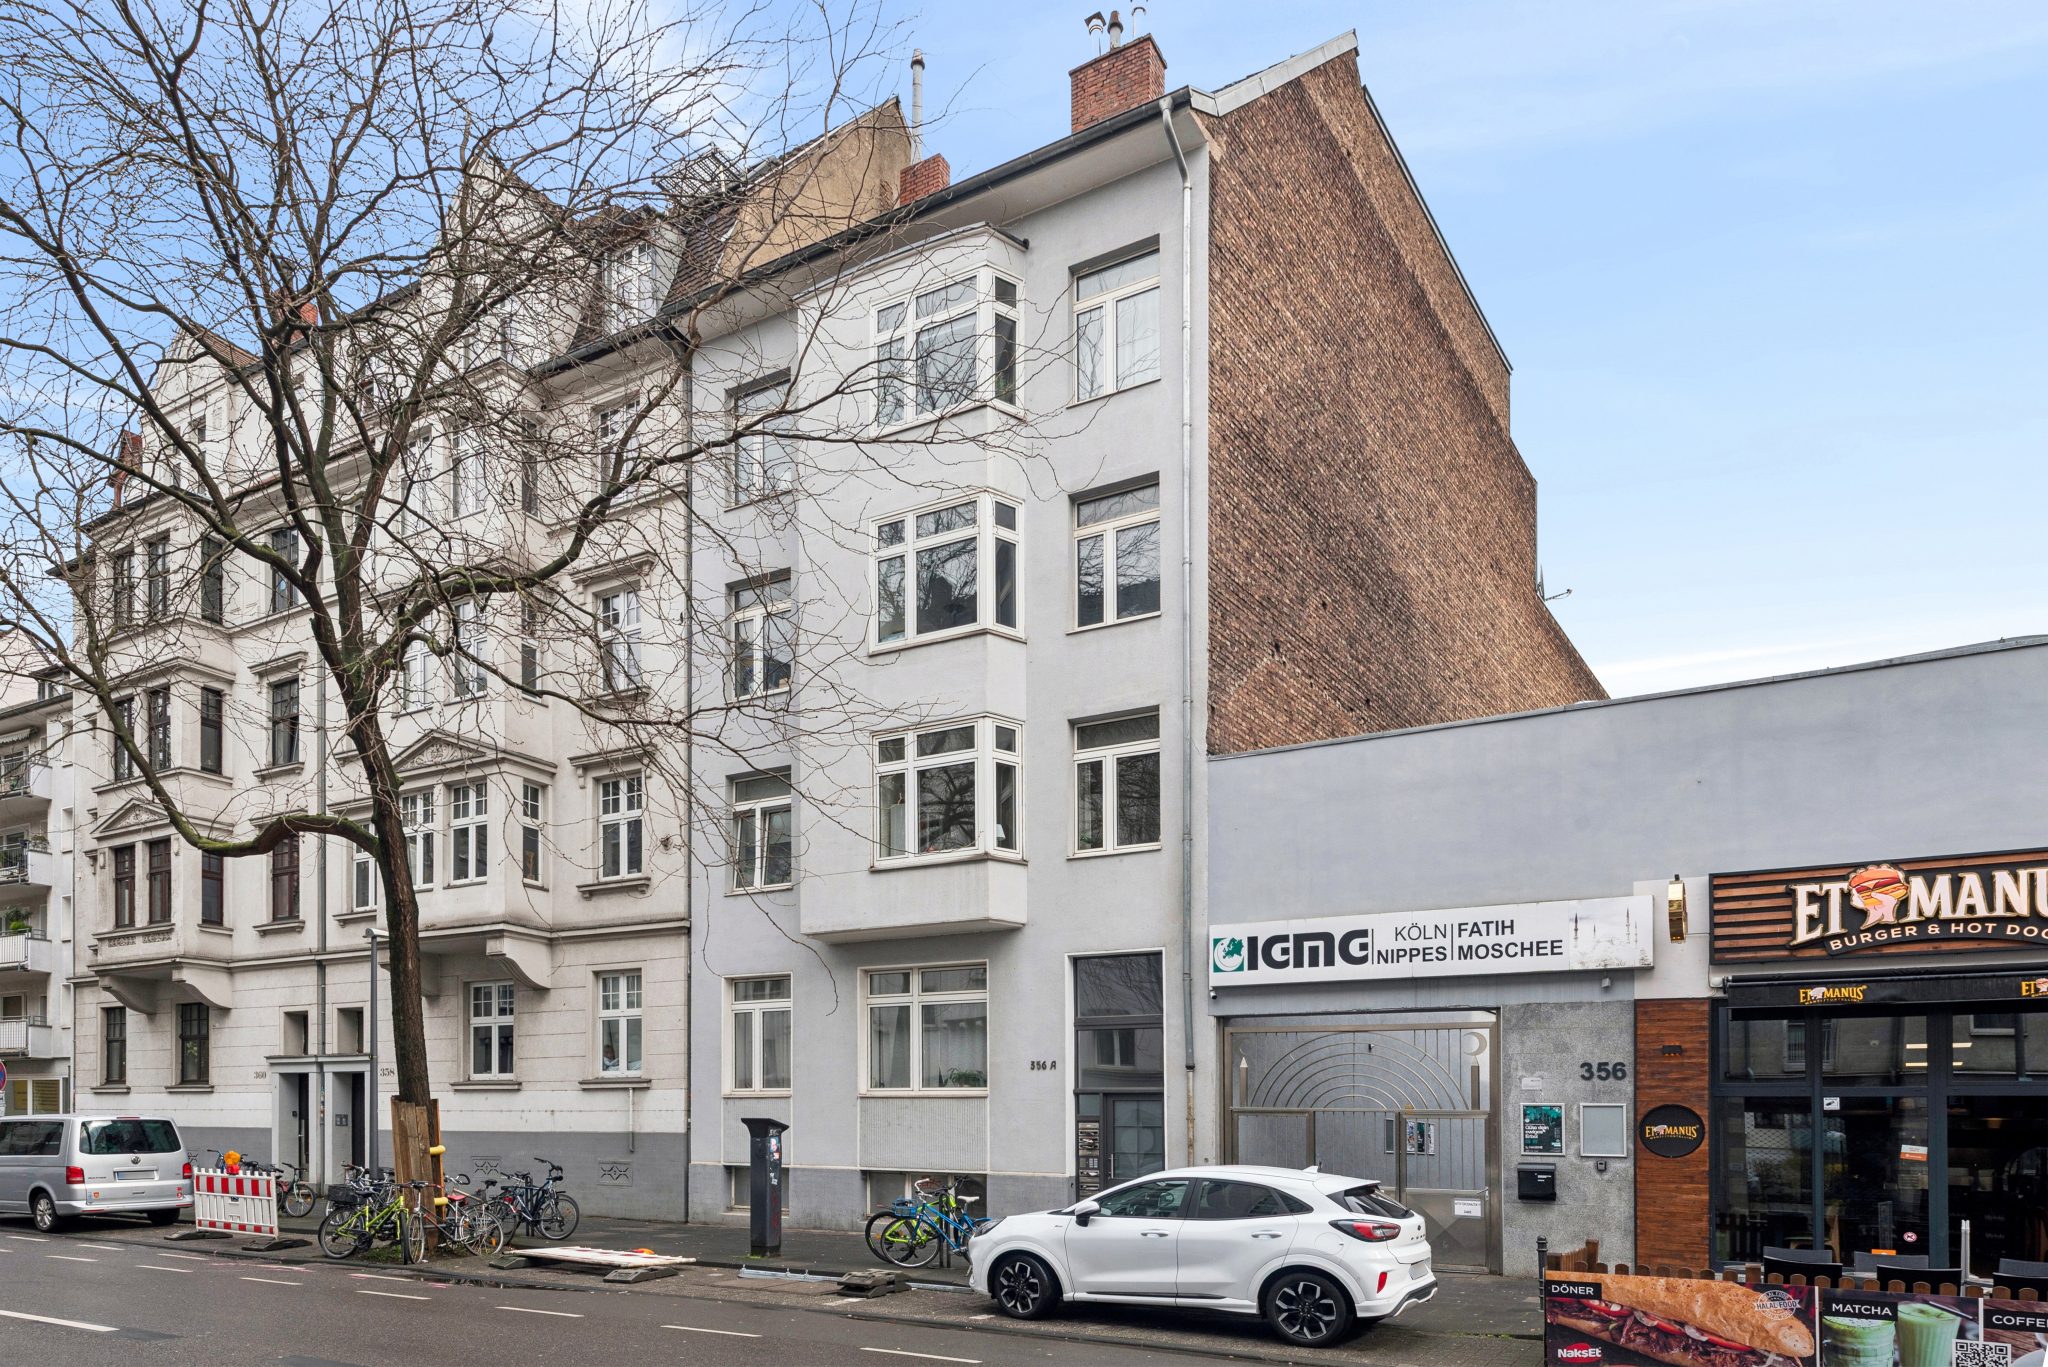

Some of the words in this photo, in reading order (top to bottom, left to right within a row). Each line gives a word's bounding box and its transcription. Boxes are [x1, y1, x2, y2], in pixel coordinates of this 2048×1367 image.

[1789, 881, 1849, 946] ET
[1394, 922, 1447, 941] KÖLN
[1457, 919, 1515, 938] FATIH
[1830, 925, 1917, 951] BURGER
[1927, 924, 1940, 934] &
[1951, 922, 1997, 934] HOT
[1247, 928, 1369, 971] IGMG
[1377, 945, 1448, 965] NIPPES
[1457, 939, 1563, 961] MOSCHEE
[1823, 986, 1864, 1001] MANUS
[379, 1068, 396, 1077] 358
[1030, 1060, 1047, 1071] 356
[1049, 1060, 1057, 1071] A
[1580, 1062, 1627, 1081] 356
[1665, 1126, 1697, 1138] MANUS
[1551, 1283, 1594, 1296] DÖNER
[1756, 1302, 1778, 1310] HALAL
[1778, 1300, 1798, 1309] FOOD
[1832, 1303, 1893, 1316] MATCHA
[1992, 1315, 2048, 1328] COFFE
